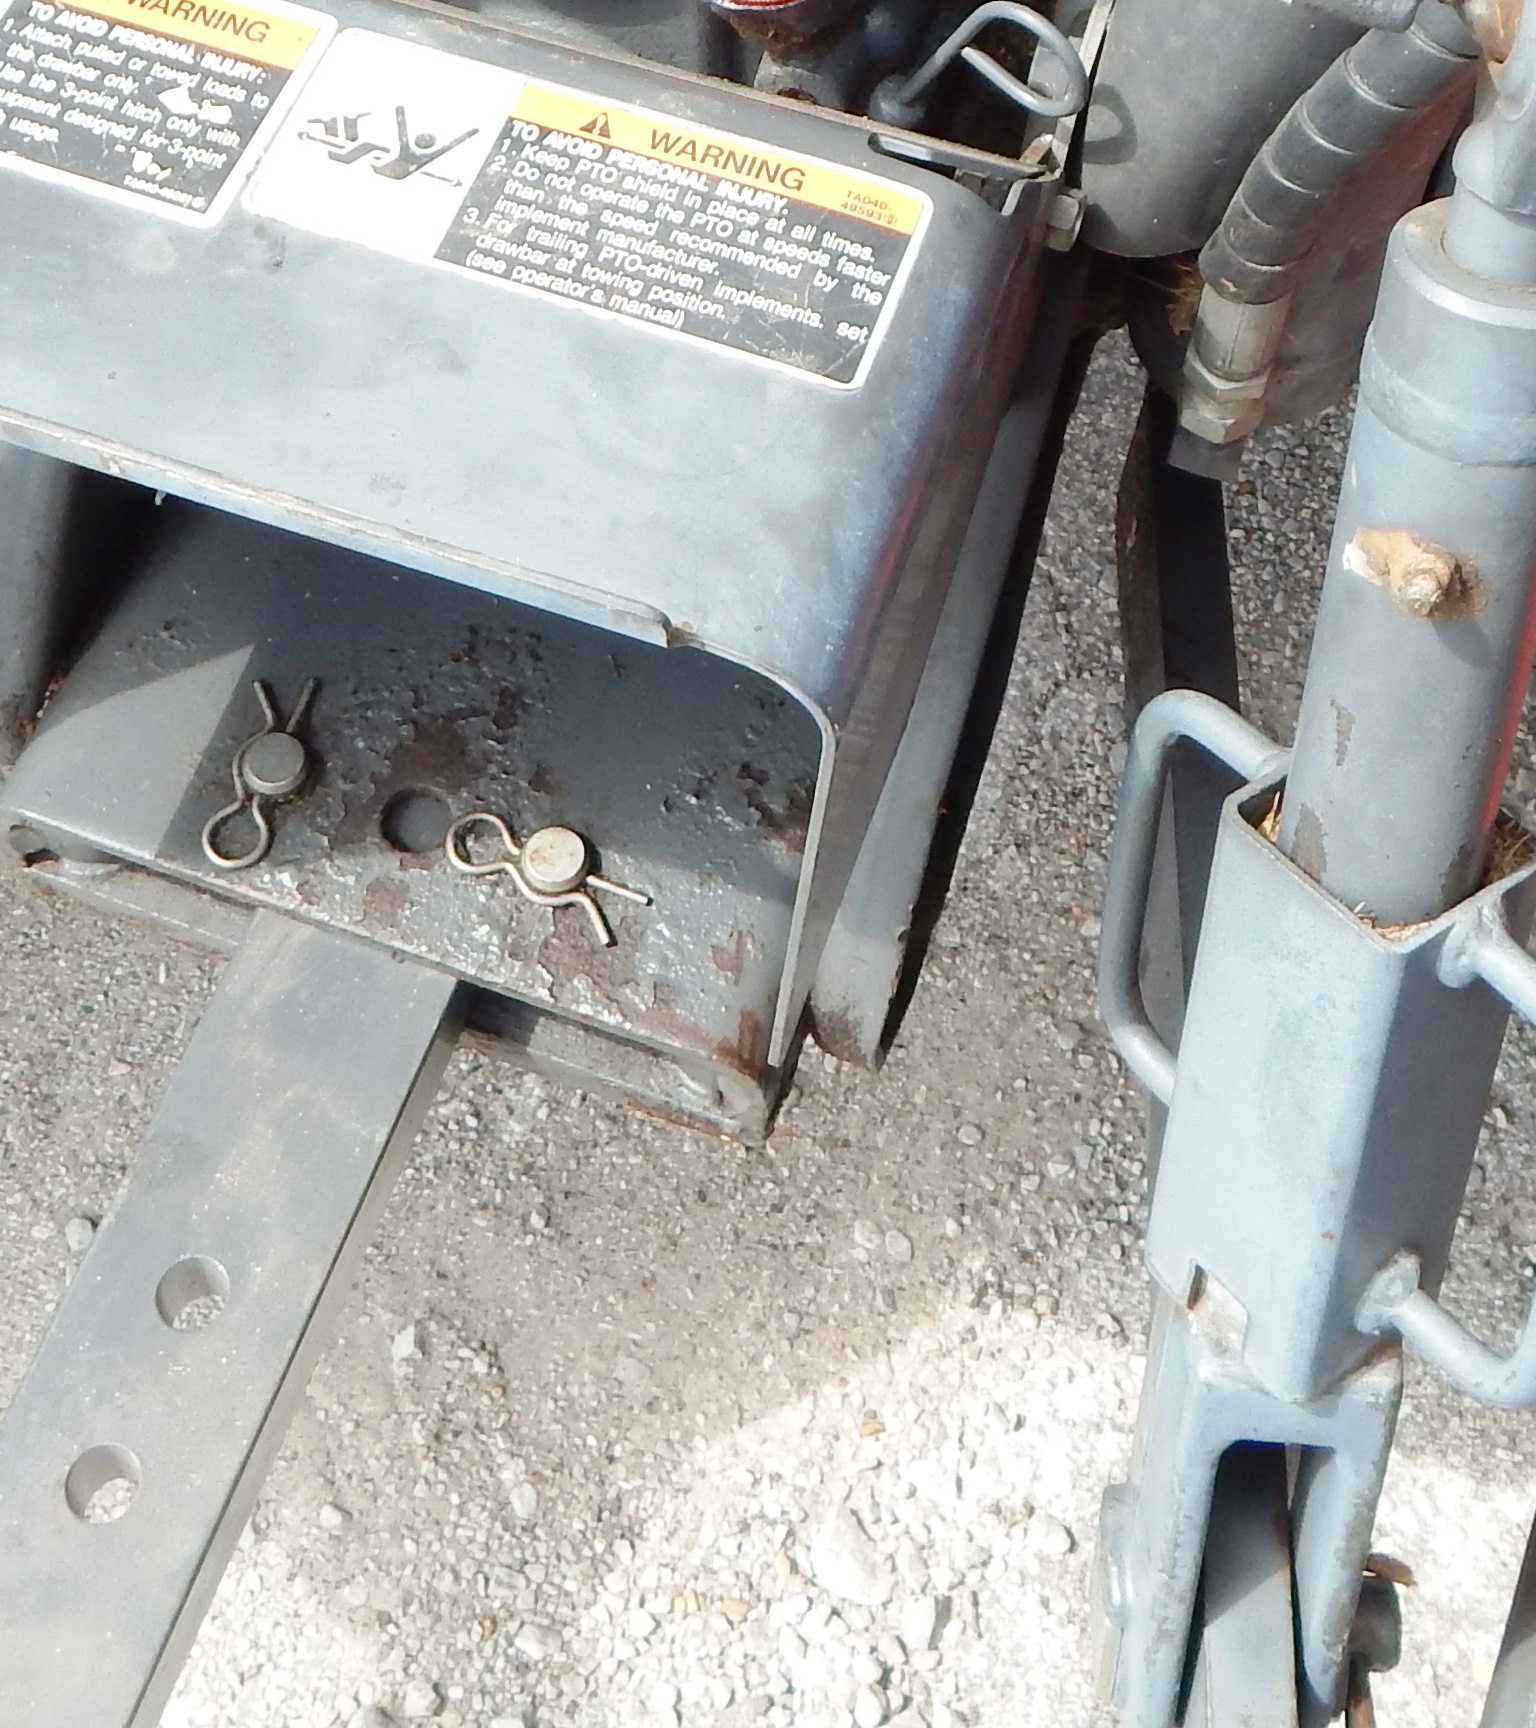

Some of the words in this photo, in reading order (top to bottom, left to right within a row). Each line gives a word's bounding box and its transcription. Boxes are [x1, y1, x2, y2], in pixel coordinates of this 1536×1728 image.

[6, 42, 36, 64] the
[37, 51, 102, 82] drawbar
[103, 71, 140, 95] only.
[19, 23, 71, 51] Attach
[74, 40, 125, 69] pulled
[128, 55, 148, 73] or
[150, 61, 202, 90] towed
[202, 78, 247, 104] loads
[250, 91, 271, 110] to
[28, 1, 55, 21] TO
[54, 9, 109, 38] AVOID
[109, 24, 195, 65] PERSONAL
[199, 49, 270, 85] INJURY:
[9, 114, 61, 144] usage.
[28, 71, 58, 94] the
[60, 81, 120, 113] 3-point
[120, 99, 164, 125] hitch
[166, 113, 202, 140] only
[205, 122, 242, 150] with
[63, 106, 138, 143] designed
[139, 128, 166, 149] for
[167, 137, 228, 169] 3-point
[511, 120, 540, 141] TO
[542, 130, 604, 160] AVOID
[606, 148, 710, 193] PERSONAL
[715, 178, 789, 215] INJURY.
[651, 129, 807, 192] WARNING
[489, 154, 508, 174] 2.
[513, 160, 541, 182] Do
[544, 172, 577, 193] not
[579, 183, 650, 214] operate
[654, 202, 686, 224] the
[689, 212, 735, 238] PTO
[737, 228, 761, 247] at
[762, 236, 832, 269] speeds
[835, 256, 893, 287] faster
[494, 194, 591, 237] implement
[595, 227, 721, 276] manufacturer.
[503, 178, 546, 203] than
[557, 194, 589, 217] the
[599, 208, 661, 237] speed
[668, 229, 803, 280] recommended
[813, 268, 840, 294] by
[851, 280, 884, 307] the
[520, 143, 571, 172] Keep
[574, 158, 619, 183] PTO
[622, 174, 680, 203] shield
[683, 188, 703, 209] in
[706, 200, 761, 227] place
[765, 217, 787, 235] at
[790, 224, 818, 243] all
[821, 231, 876, 263] times.
[463, 207, 481, 226] 3.
[483, 212, 519, 235] For
[525, 225, 590, 261] trailing
[597, 245, 705, 292] PTO-driven
[836, 322, 870, 345] set
[465, 249, 507, 275] (see
[511, 265, 606, 304] operator's
[608, 292, 686, 330] manual)
[475, 233, 553, 266] drawbar
[555, 258, 578, 275] at
[580, 262, 645, 297] towing
[647, 285, 727, 320] position.
